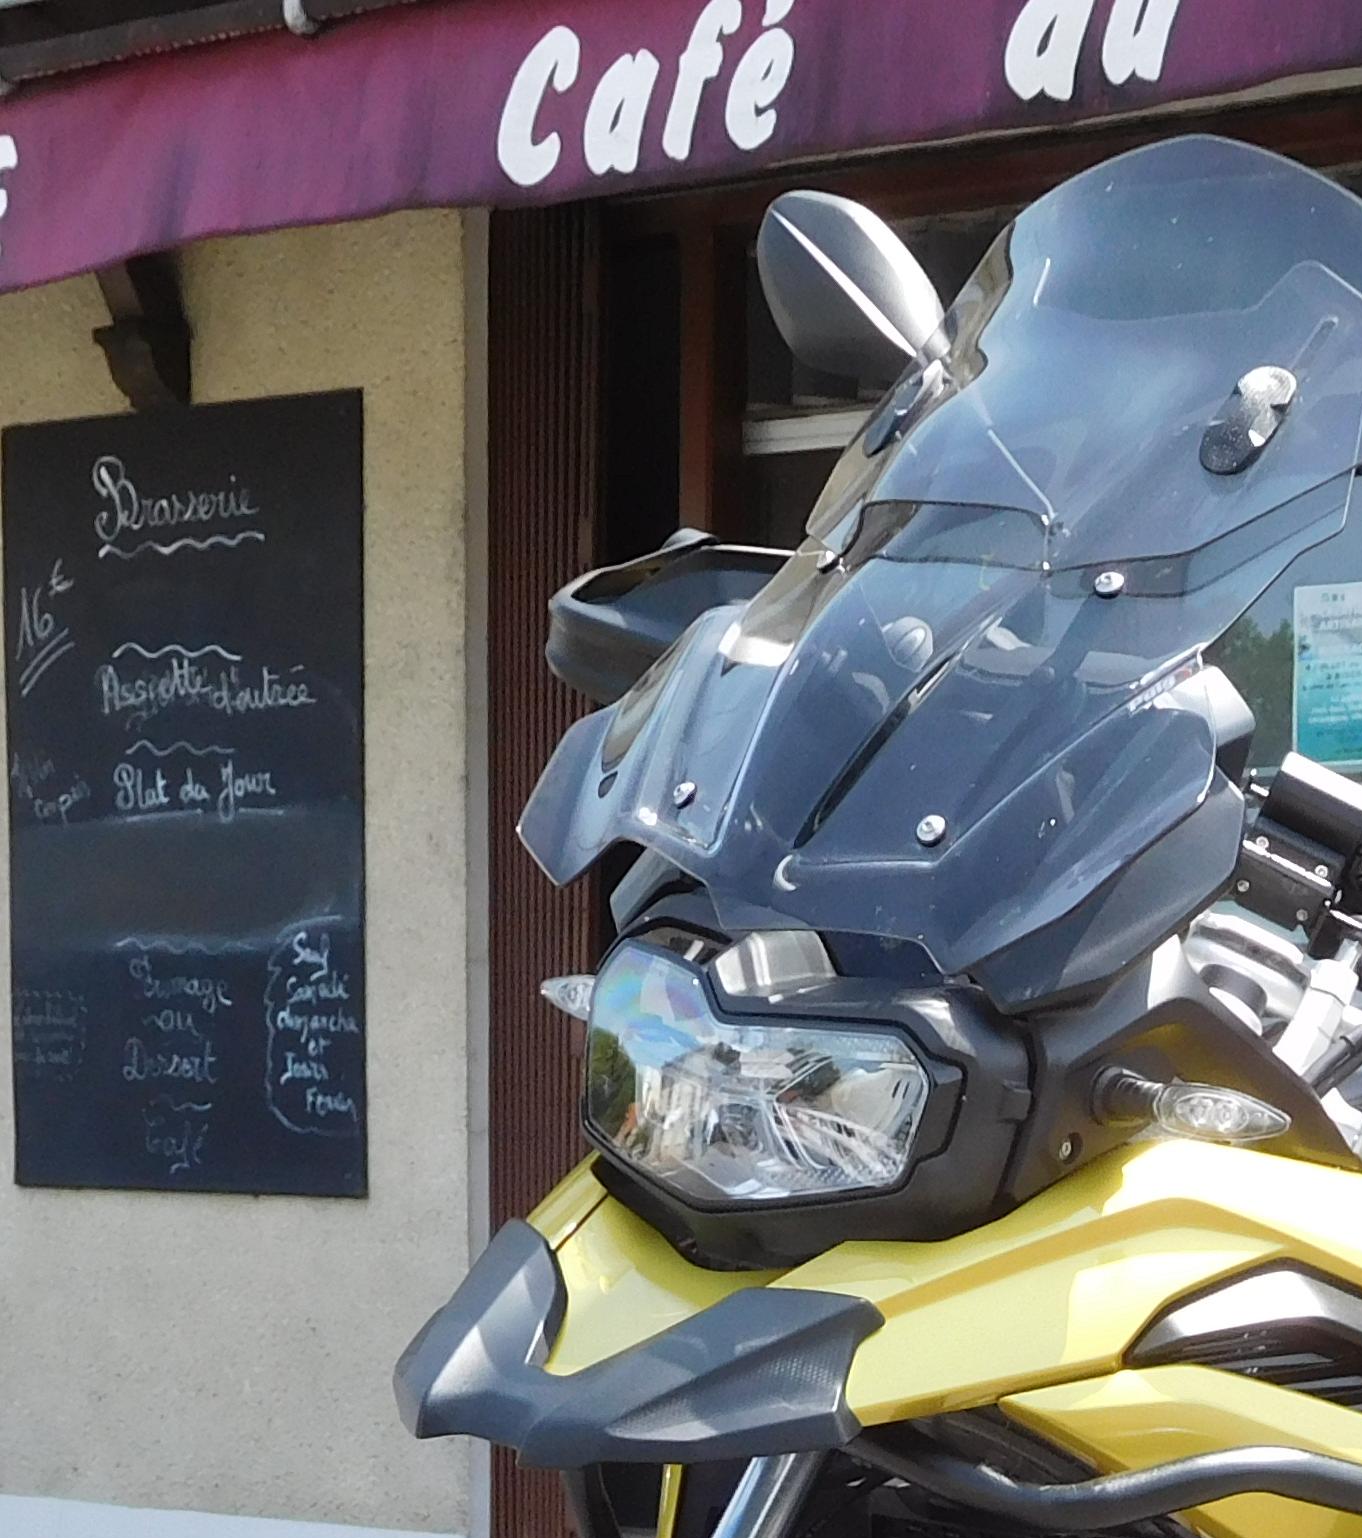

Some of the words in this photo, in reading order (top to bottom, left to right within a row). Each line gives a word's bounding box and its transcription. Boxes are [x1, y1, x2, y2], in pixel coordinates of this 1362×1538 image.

[497, 0, 795, 187] Café
[92, 456, 260, 541] Brasserie
[113, 762, 170, 811] Plat
[179, 767, 211, 804] du
[218, 758, 277, 824] Jour
